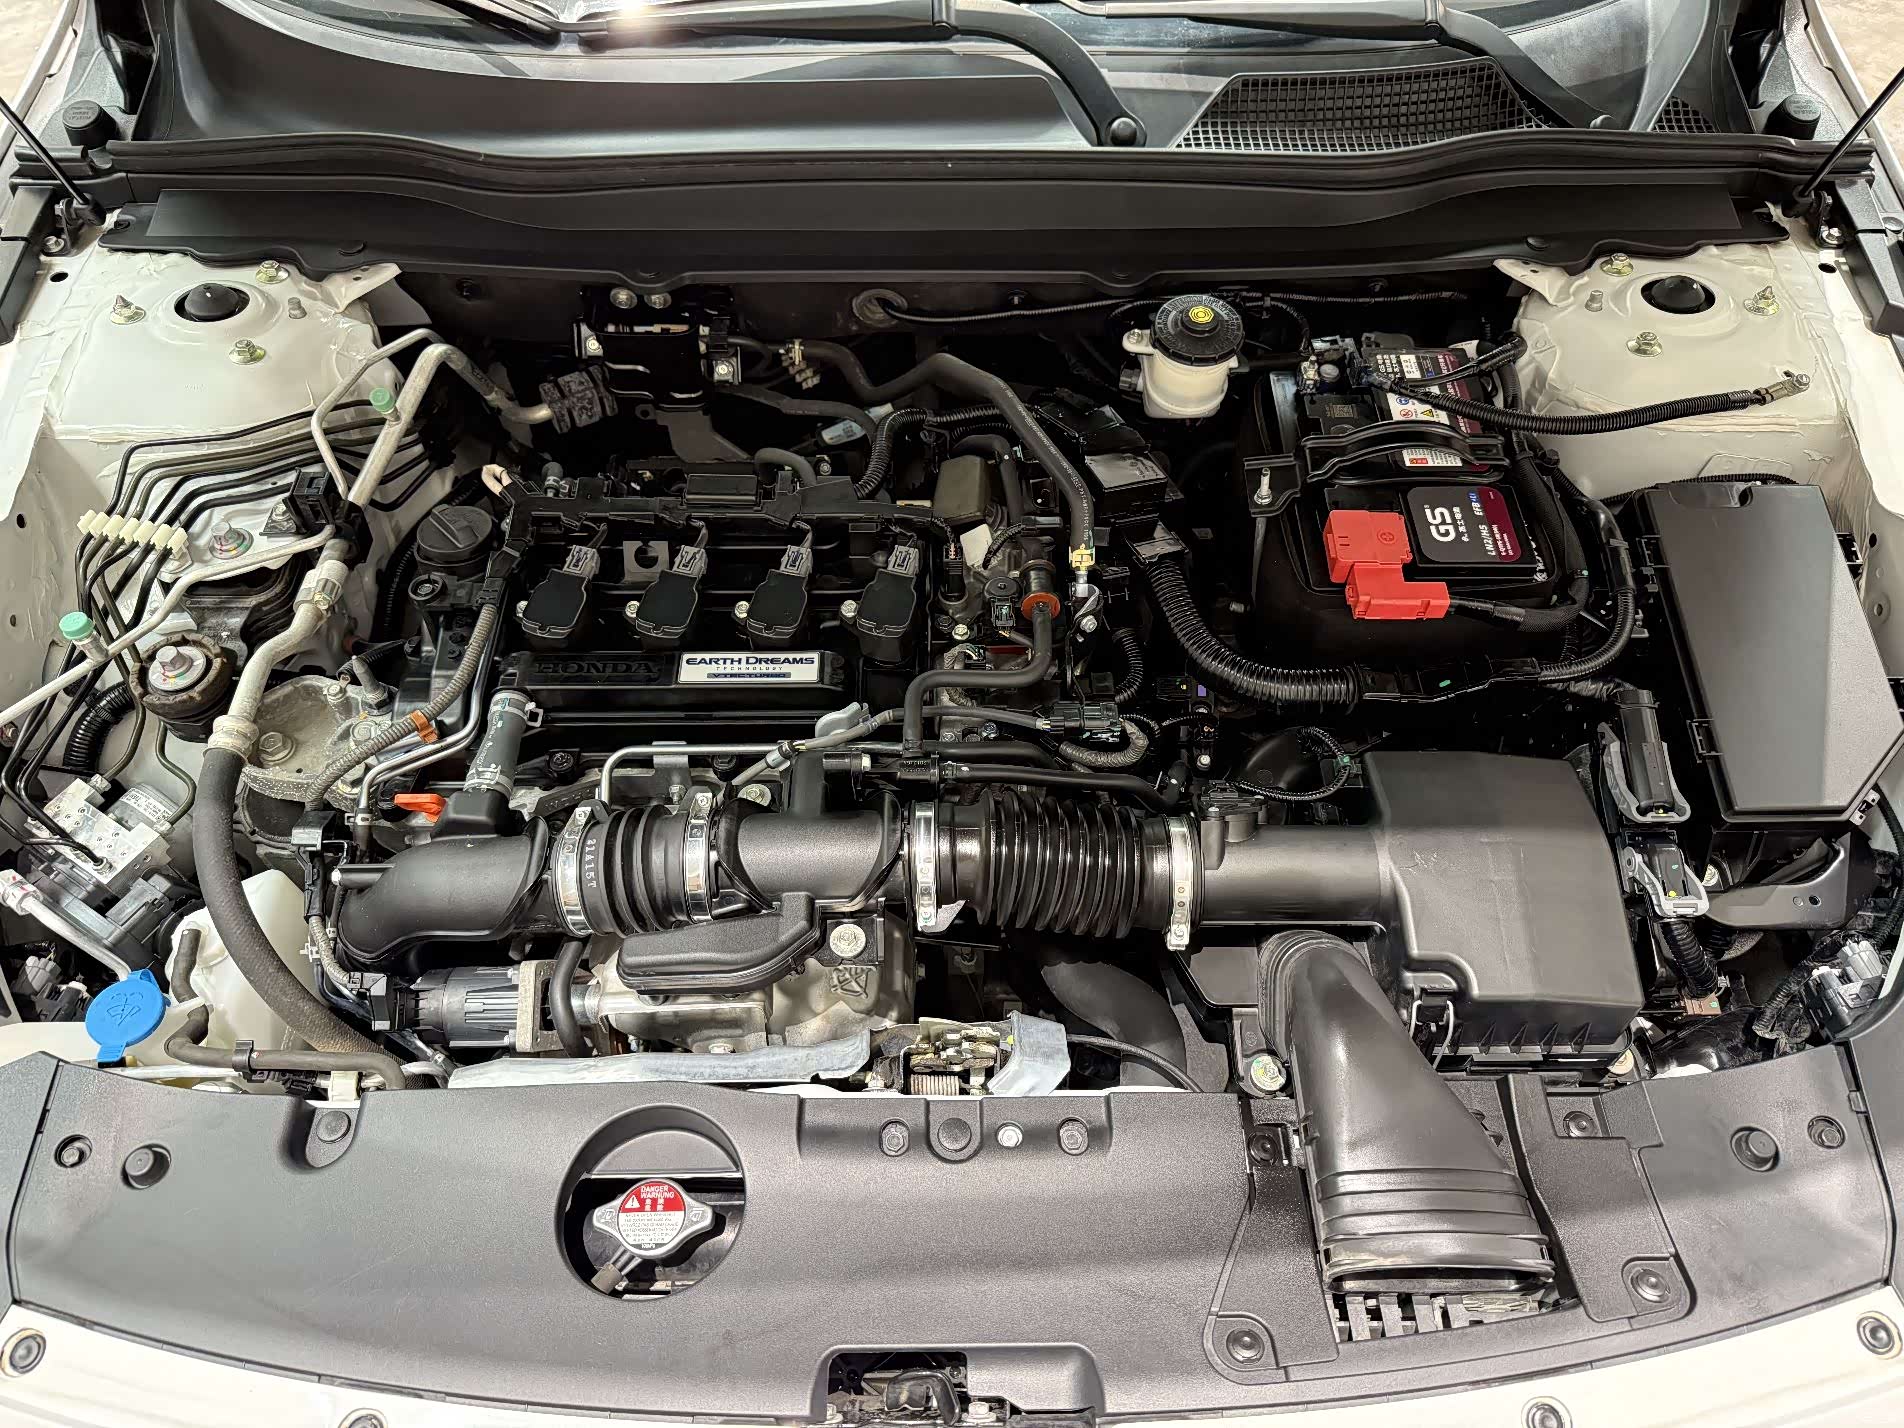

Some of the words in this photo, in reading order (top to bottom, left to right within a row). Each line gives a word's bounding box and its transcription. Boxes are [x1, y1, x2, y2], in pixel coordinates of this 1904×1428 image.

[1424, 507, 1456, 542] GS
[685, 657, 743, 666] EARTH
[745, 656, 815, 665] DREAMS
[534, 661, 658, 675] HONDA
[640, 1191, 674, 1199] WARNUNG
